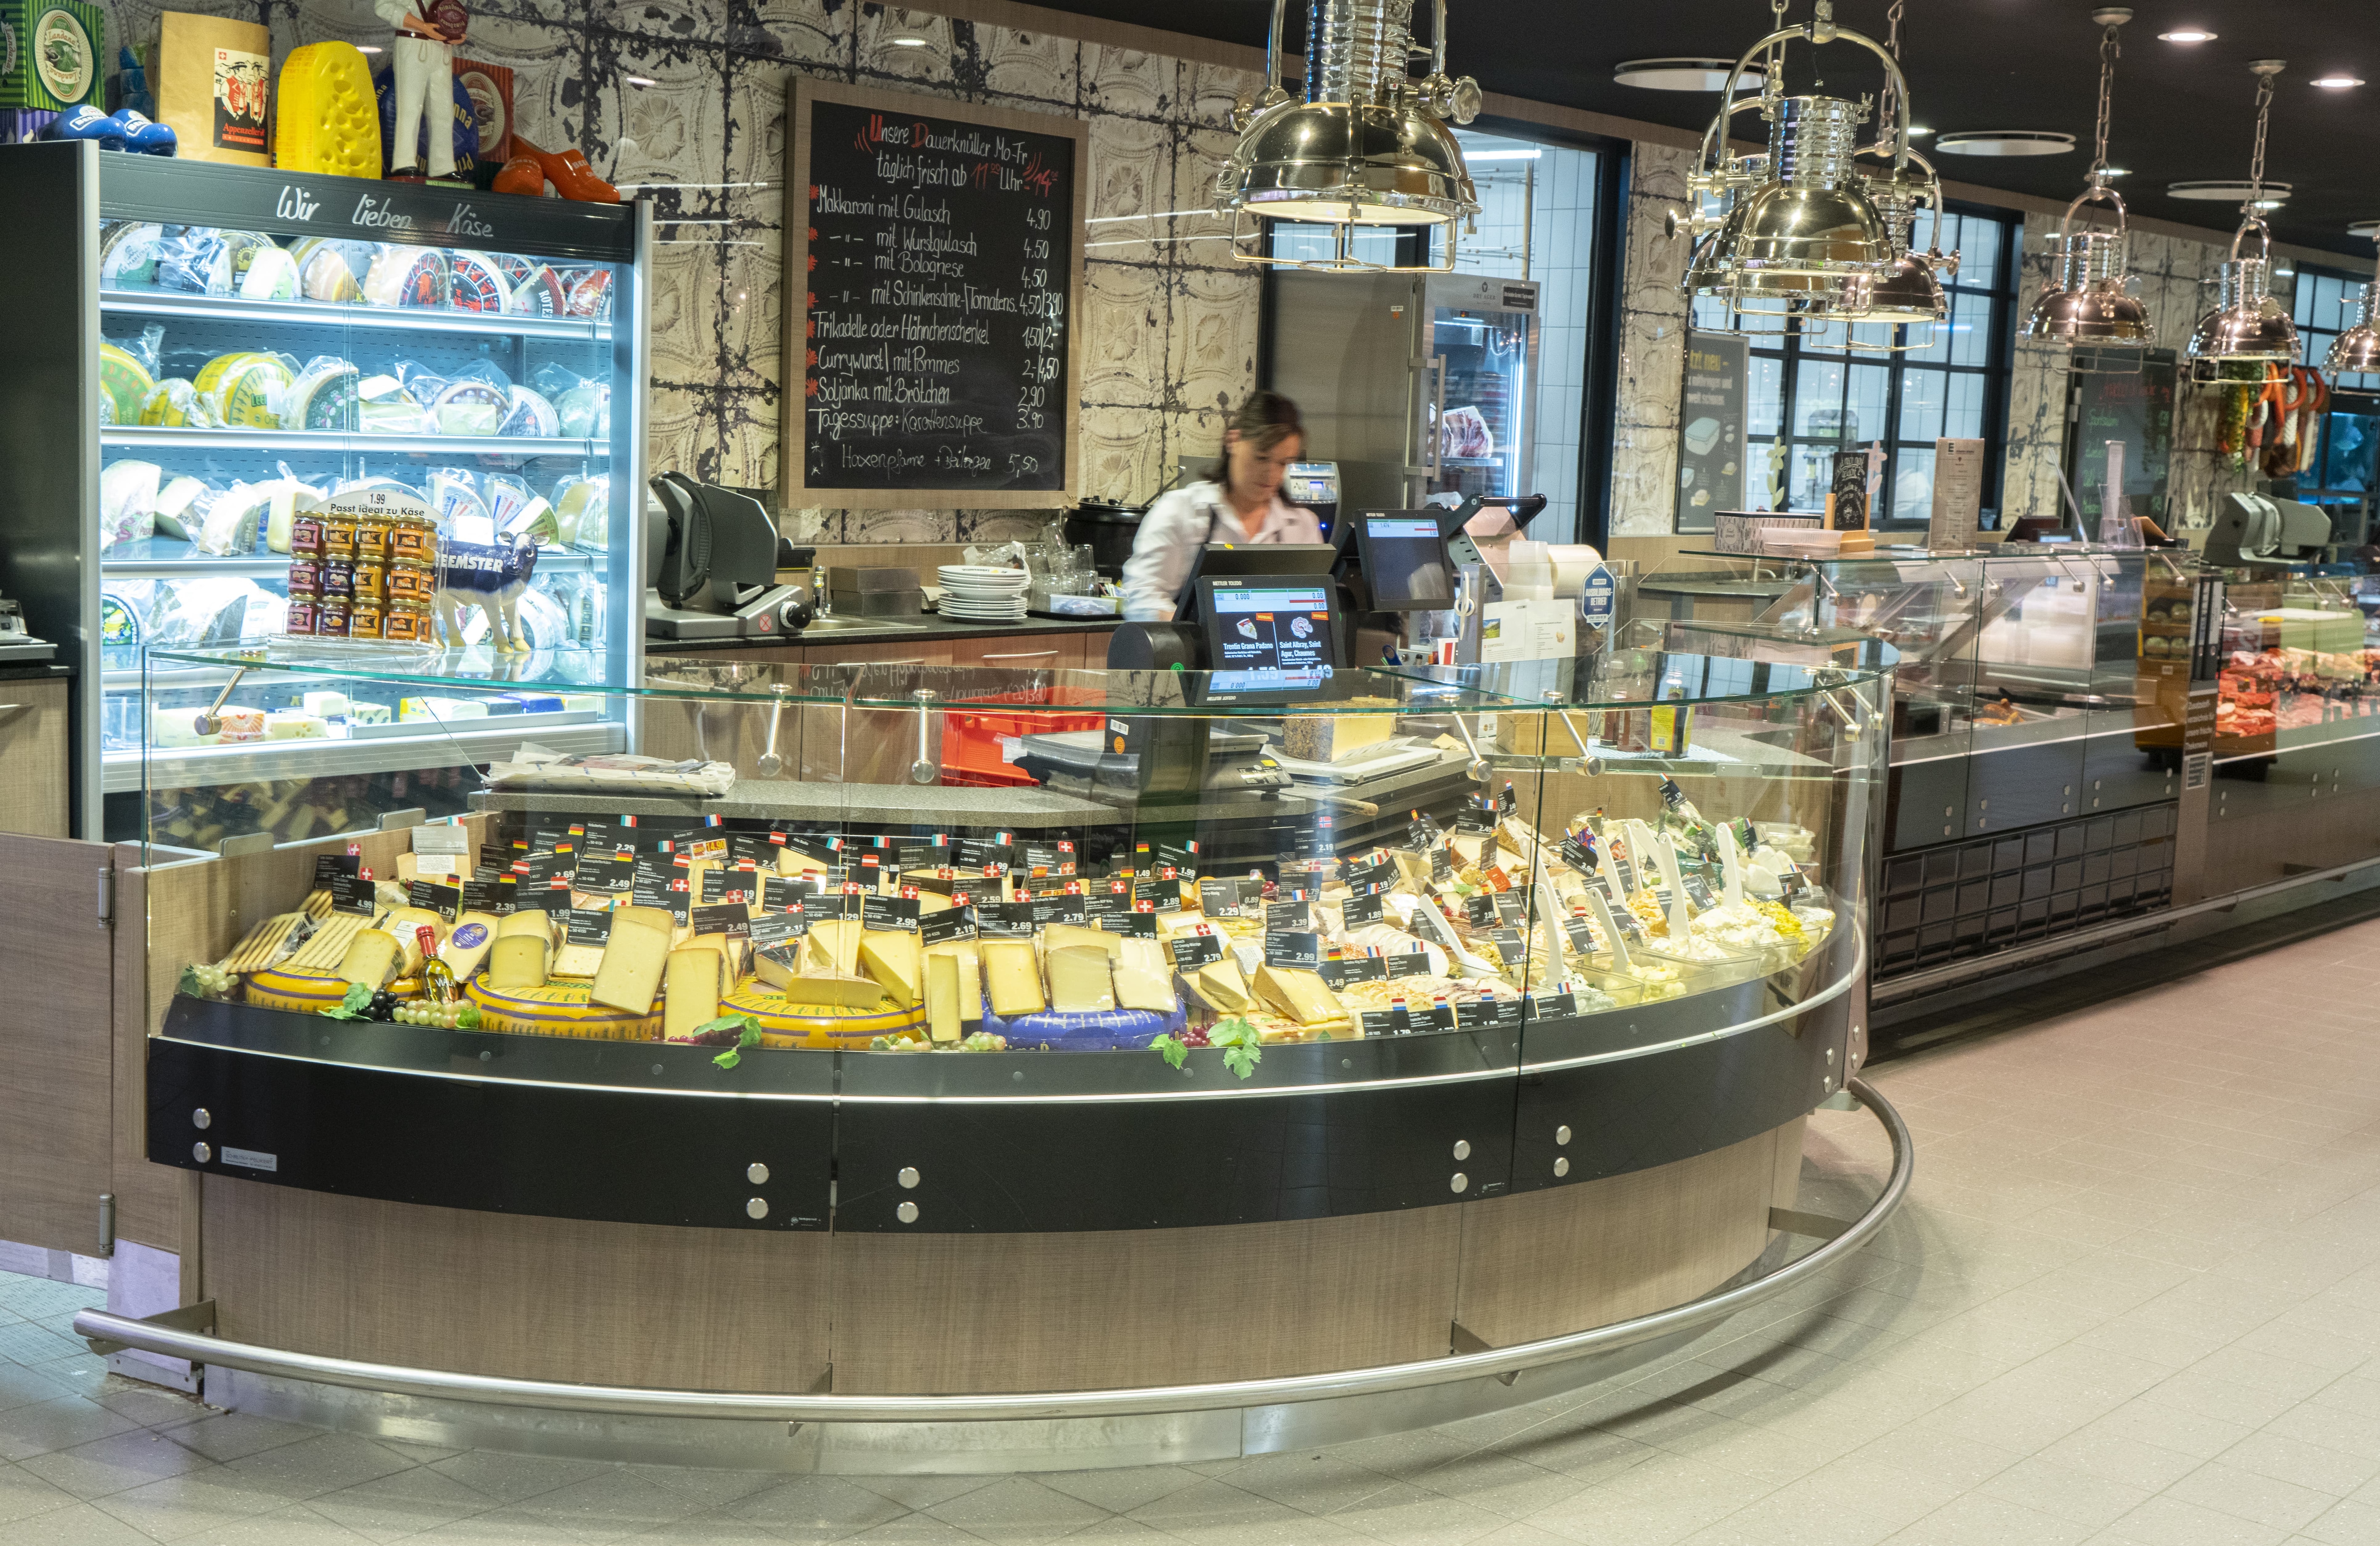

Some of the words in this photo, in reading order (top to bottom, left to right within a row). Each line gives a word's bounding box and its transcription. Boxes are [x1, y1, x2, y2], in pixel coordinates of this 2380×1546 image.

[871, 114, 909, 145] Unsere
[912, 122, 991, 157] Dauerknüller
[994, 138, 1027, 165] Mo-Fr
[876, 150, 915, 184] täglich
[913, 155, 948, 189] frisch
[952, 163, 967, 186] ab
[1000, 170, 1023, 191] Uhr
[817, 184, 874, 215] Makkaroni
[879, 195, 900, 218] mit
[904, 194, 950, 224] Gulasch
[277, 185, 320, 221] Wir
[446, 203, 494, 238] Käse
[877, 224, 897, 248] mit
[903, 226, 977, 258] Wurstgulasch
[875, 247, 896, 270] mit
[900, 251, 964, 280] Bolognese
[872, 279, 891, 304] mit
[812, 311, 867, 338] Frikadelle
[871, 315, 899, 338] oder
[902, 314, 989, 344] Hähnchenschenkel
[893, 348, 912, 370] mit
[912, 346, 960, 374] Pommes
[817, 377, 870, 409] Soljanka
[873, 376, 893, 402] mit
[895, 377, 950, 404] Brötchen
[370, 493, 385, 505] 1.99
[331, 503, 356, 513] Passt
[358, 505, 383, 514] ideal
[401, 507, 425, 516] Käse
[706, 840, 726, 851] 14.90
[1319, 843, 1333, 851] 2.19
[763, 859, 776, 868] 2.4
[990, 861, 1008, 870] 199
[1181, 867, 1196, 877] 1.99
[609, 879, 630, 888] 2.49
[357, 899, 373, 909] 4.99
[496, 903, 516, 911] 2.39
[1163, 897, 1180, 907] 2.89
[438, 906, 456, 916] 1.79
[1219, 908, 1239, 917] 2.29
[1368, 911, 1382, 919] 1.89
[896, 917, 917, 926] 2.99
[1063, 913, 1084, 922] 2.79
[1292, 918, 1308, 927] 3.39
[727, 922, 748, 932] 2.49
[954, 924, 976, 935] 2.19
[1012, 922, 1032, 930] 2.69
[1204, 953, 1222, 962] 2.79
[1296, 952, 1315, 961] 2.99
[1328, 978, 1345, 987] 3.49
